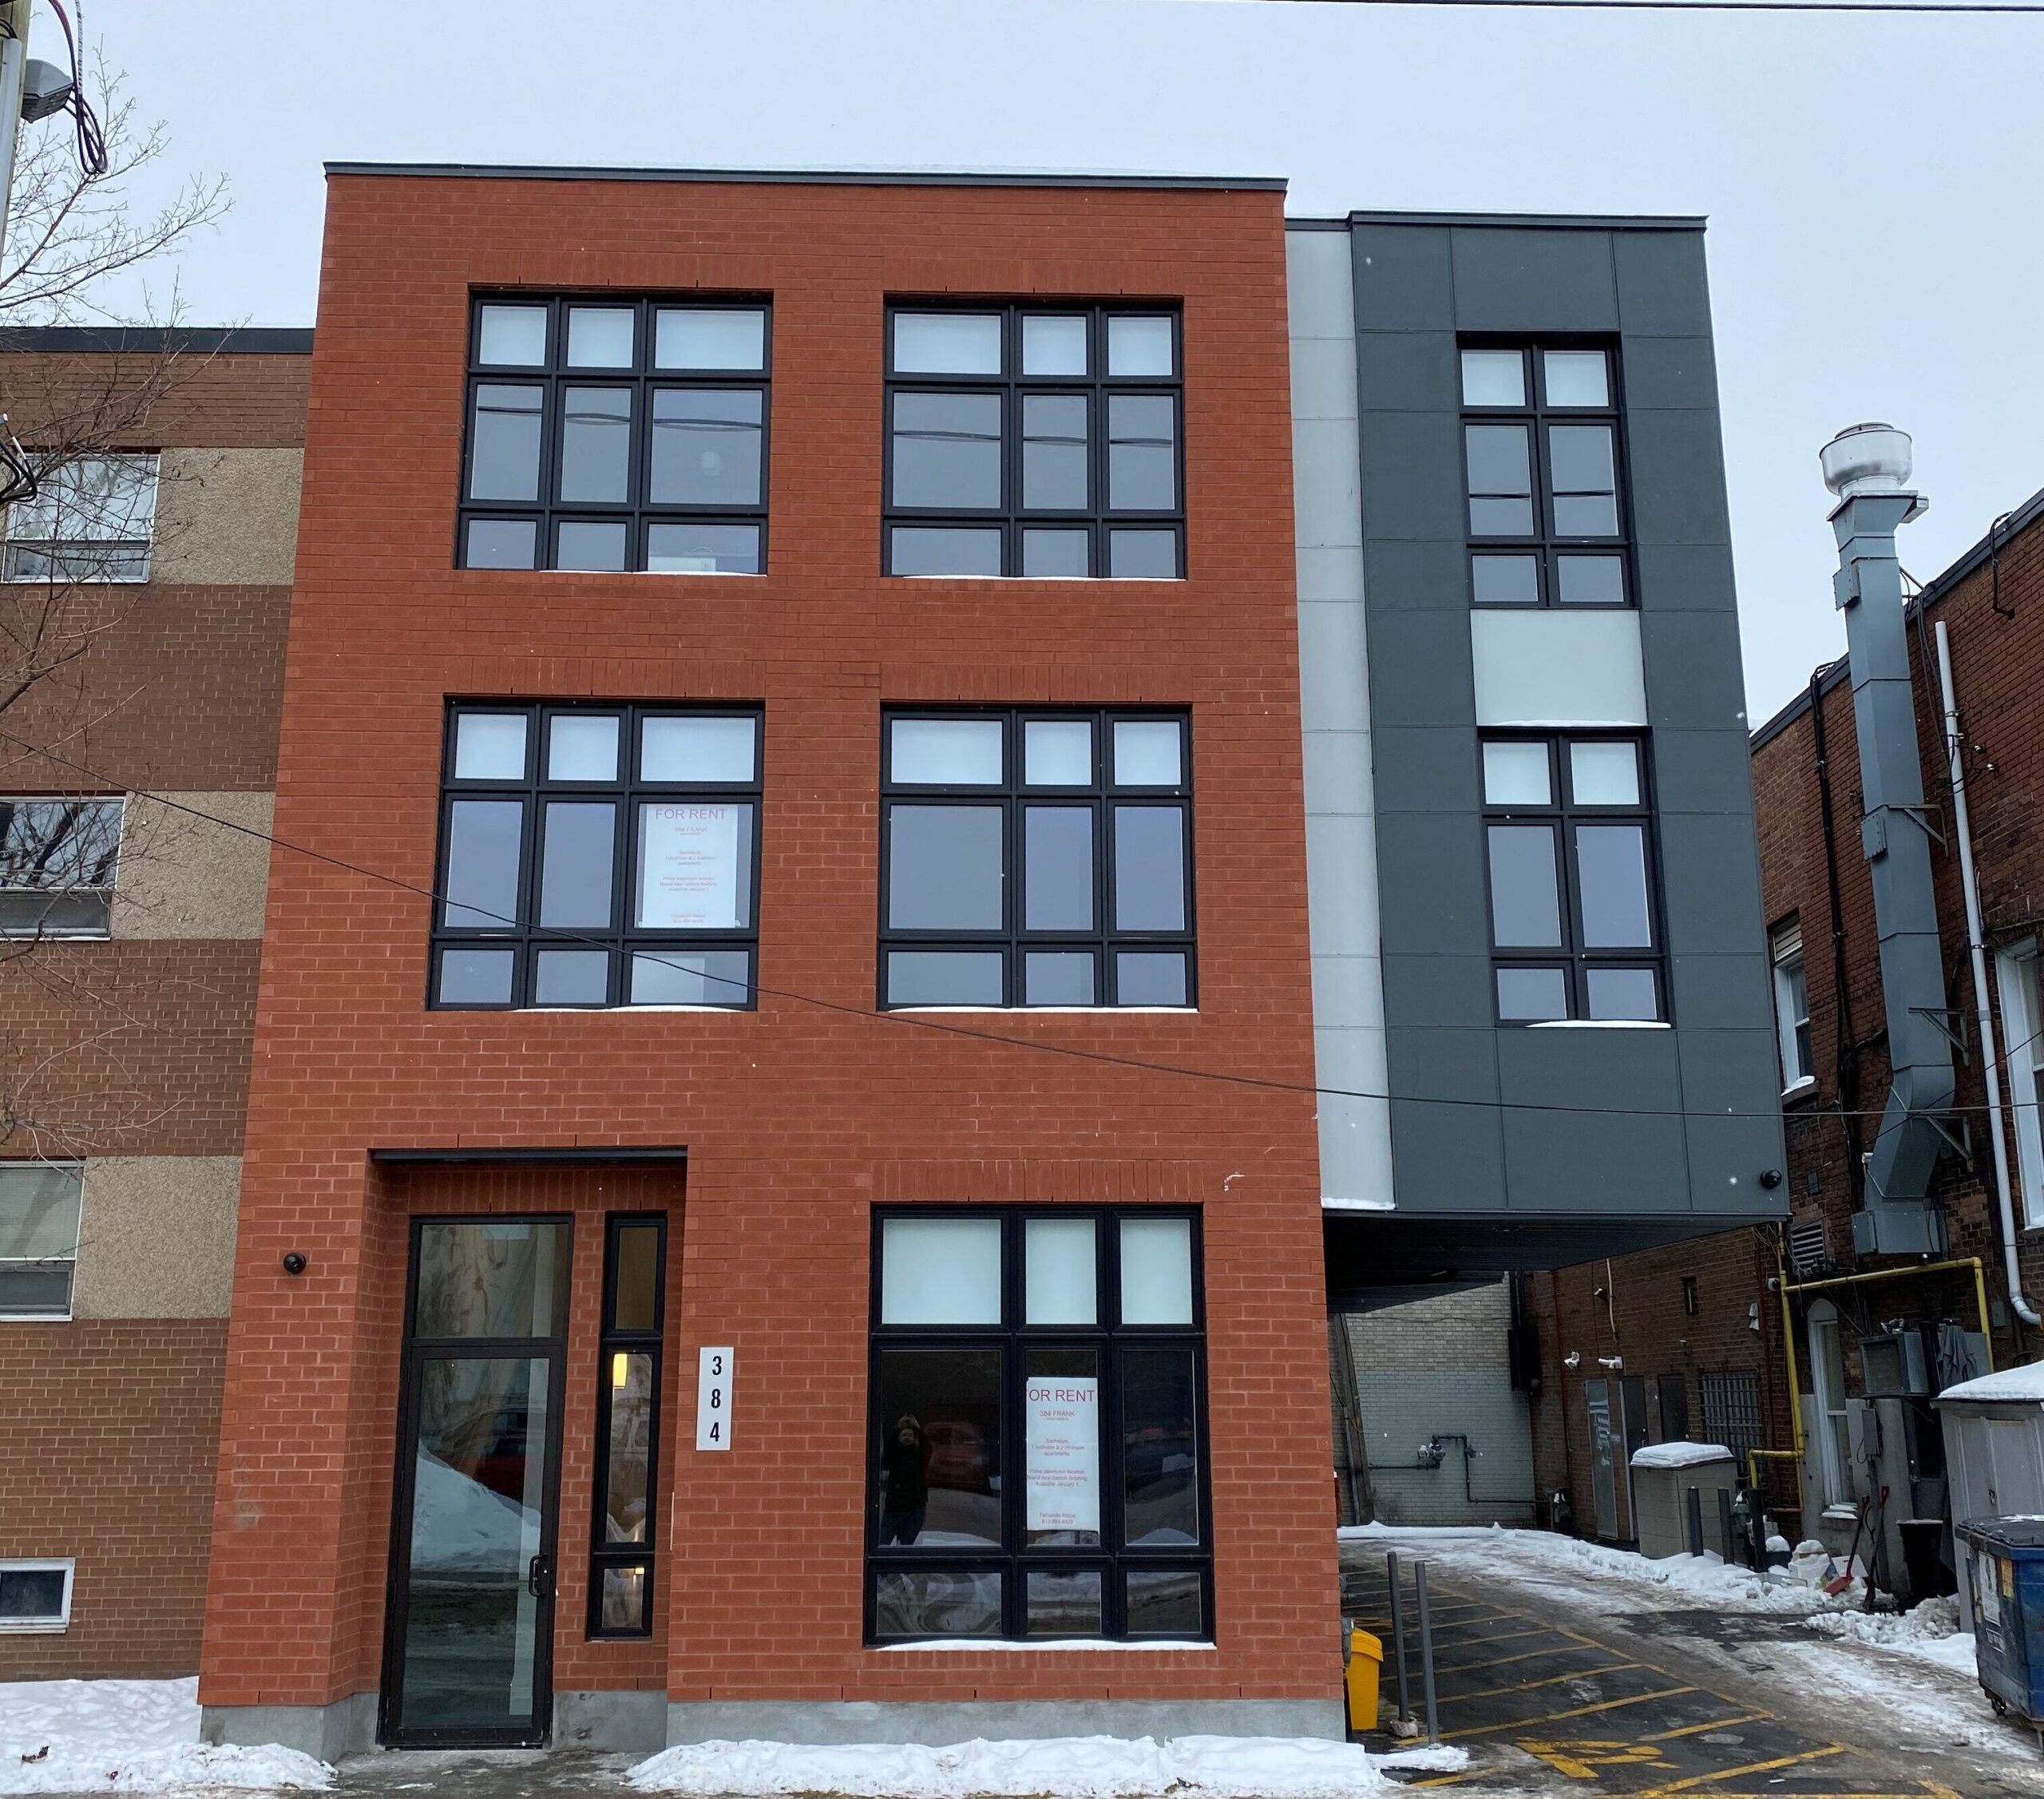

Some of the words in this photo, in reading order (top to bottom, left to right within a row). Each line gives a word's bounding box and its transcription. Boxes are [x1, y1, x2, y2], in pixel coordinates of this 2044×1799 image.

[656, 808, 684, 819] FOR
[689, 808, 727, 819] RENT
[709, 1355, 722, 1442] 384
[1056, 1389, 1095, 1402] RENT
